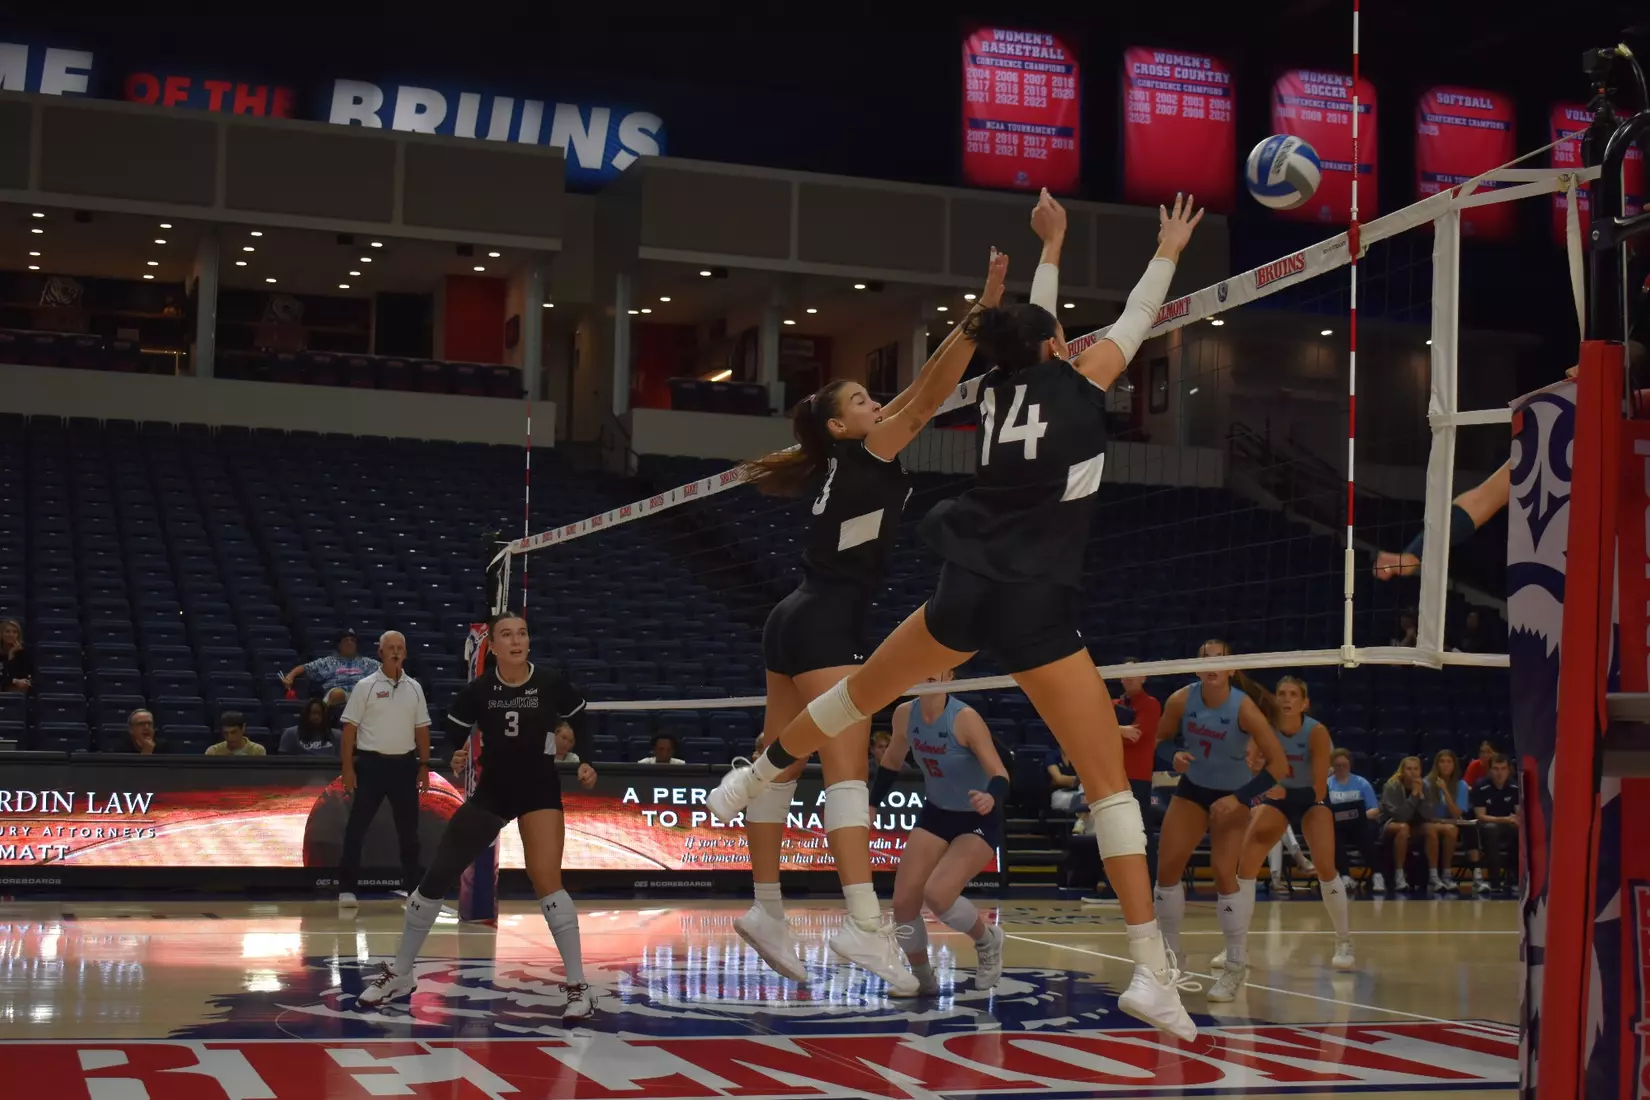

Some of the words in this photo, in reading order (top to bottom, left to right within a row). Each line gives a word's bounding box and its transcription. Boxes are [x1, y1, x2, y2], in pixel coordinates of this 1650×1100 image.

[993, 29, 1053, 45] WOMEN'S
[981, 41, 1065, 60] BASKETBALL
[975, 57, 1022, 69] CONFERENCE
[1024, 62, 1066, 73] CHAMPIONS
[1154, 52, 1211, 68] WOMEN'S
[1133, 63, 1170, 77] CROSS
[1174, 67, 1230, 84] COUNTRY
[1137, 79, 1182, 91] CONFERENCE
[1182, 84, 1223, 95] CHAMPIONS
[1304, 85, 1347, 98] SOCCER
[1436, 93, 1493, 109] SOFTBALL
[125, 72, 191, 108] OF
[203, 79, 295, 118] THE
[329, 78, 664, 171] BRUINS
[1007, 124, 1056, 136] TOURNAMENT
[1255, 252, 1305, 289] BRUINS
[979, 384, 1048, 466] 14
[504, 710, 519, 737] 3
[1199, 740, 1211, 759] 7
[86, 792, 154, 814] LAW
[622, 787, 640, 804] A
[642, 810, 678, 827] TO
[43, 826, 156, 839] ATTORNEYS
[681, 852, 698, 863] the
[650, 880, 712, 888] SCOREBOARDS
